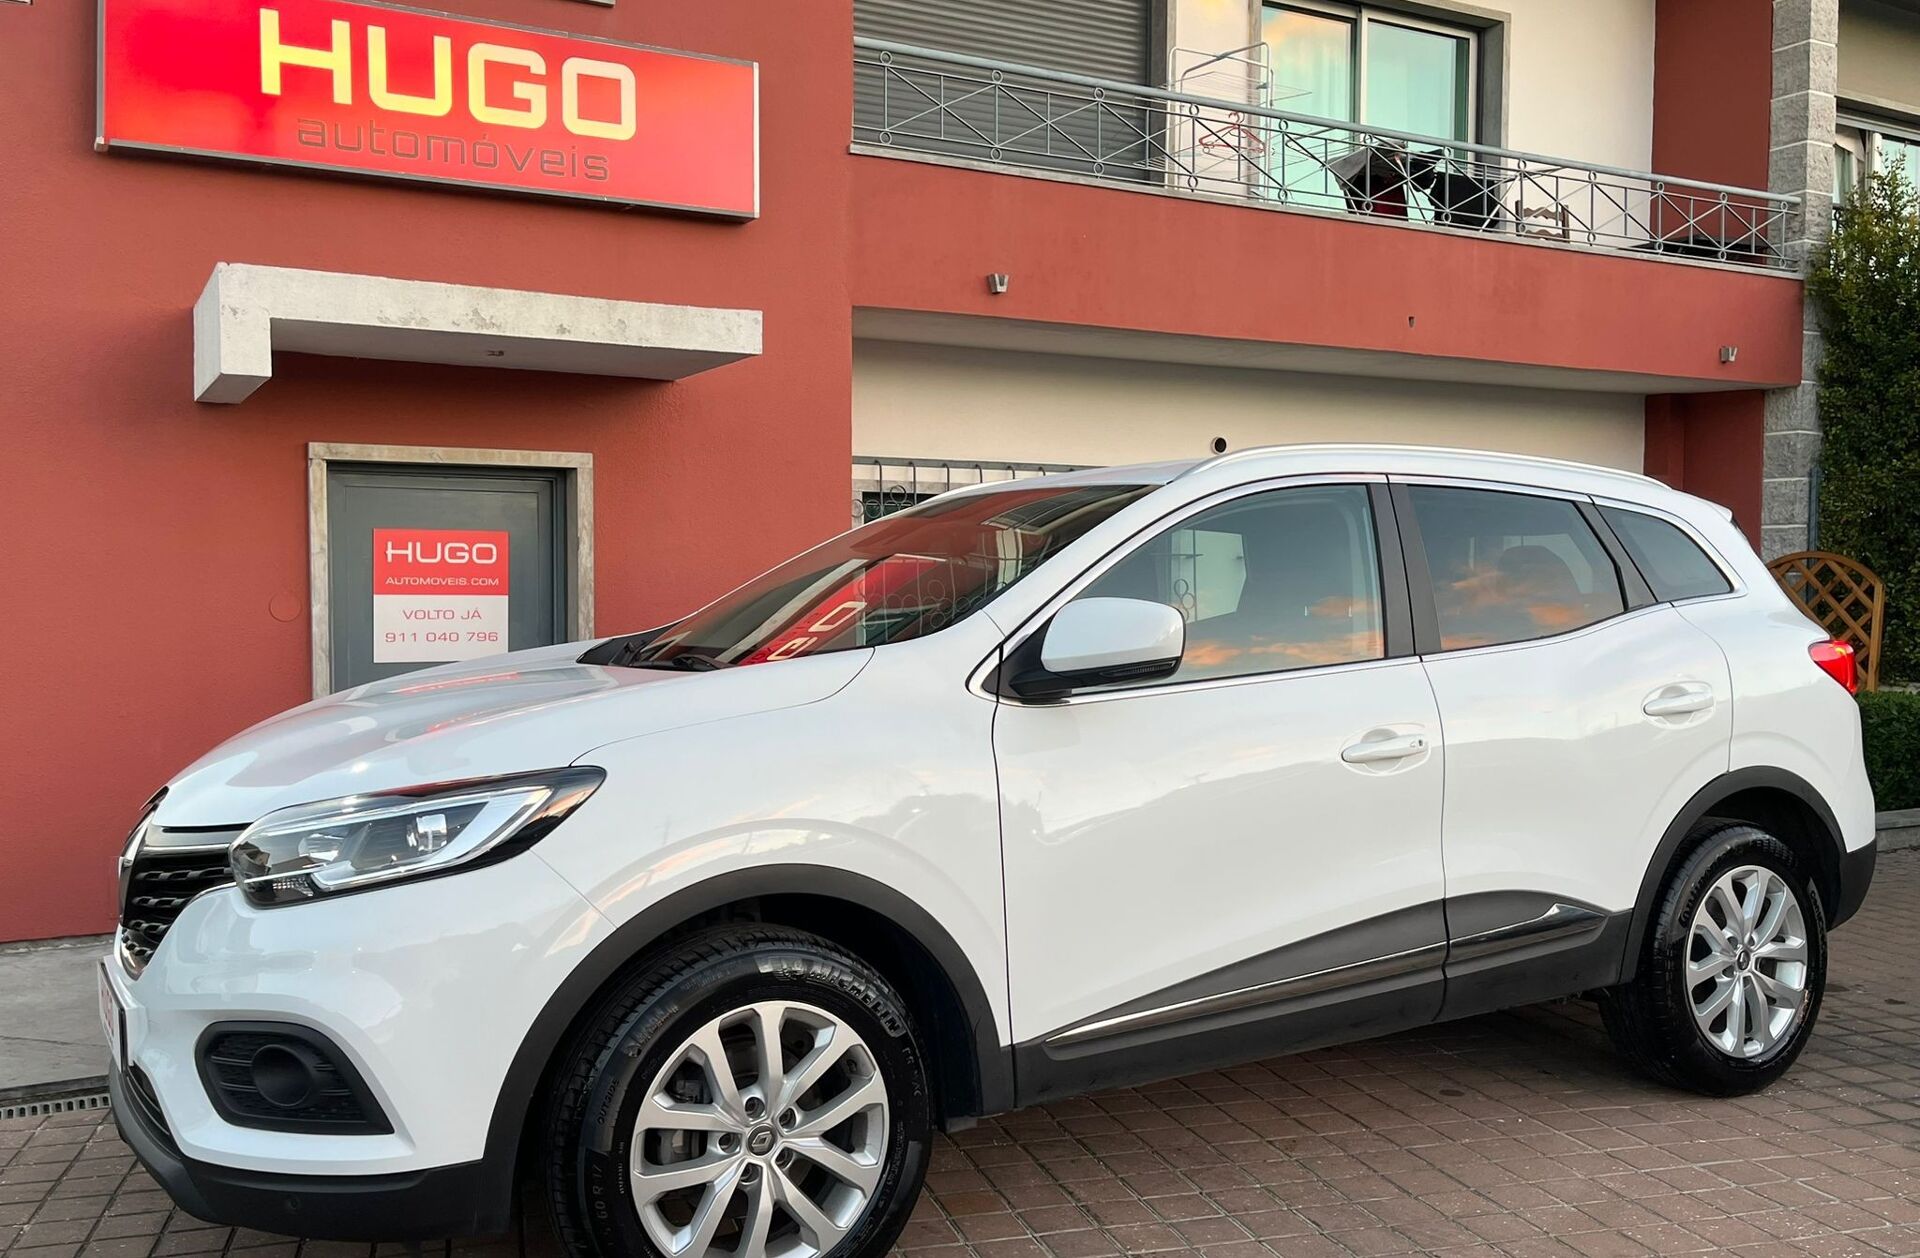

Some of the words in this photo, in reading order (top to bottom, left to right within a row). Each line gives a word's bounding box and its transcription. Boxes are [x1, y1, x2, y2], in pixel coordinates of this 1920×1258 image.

[259, 7, 637, 142] HUGO
[297, 117, 611, 182] automóveis
[386, 540, 498, 565] HUGO
[385, 576, 500, 586] AUTOMOVEIS.COM
[402, 609, 455, 620] VOLTO
[461, 608, 482, 620] JÁ
[385, 632, 418, 643] 911
[426, 632, 460, 643] 040
[467, 631, 499, 642] 796
